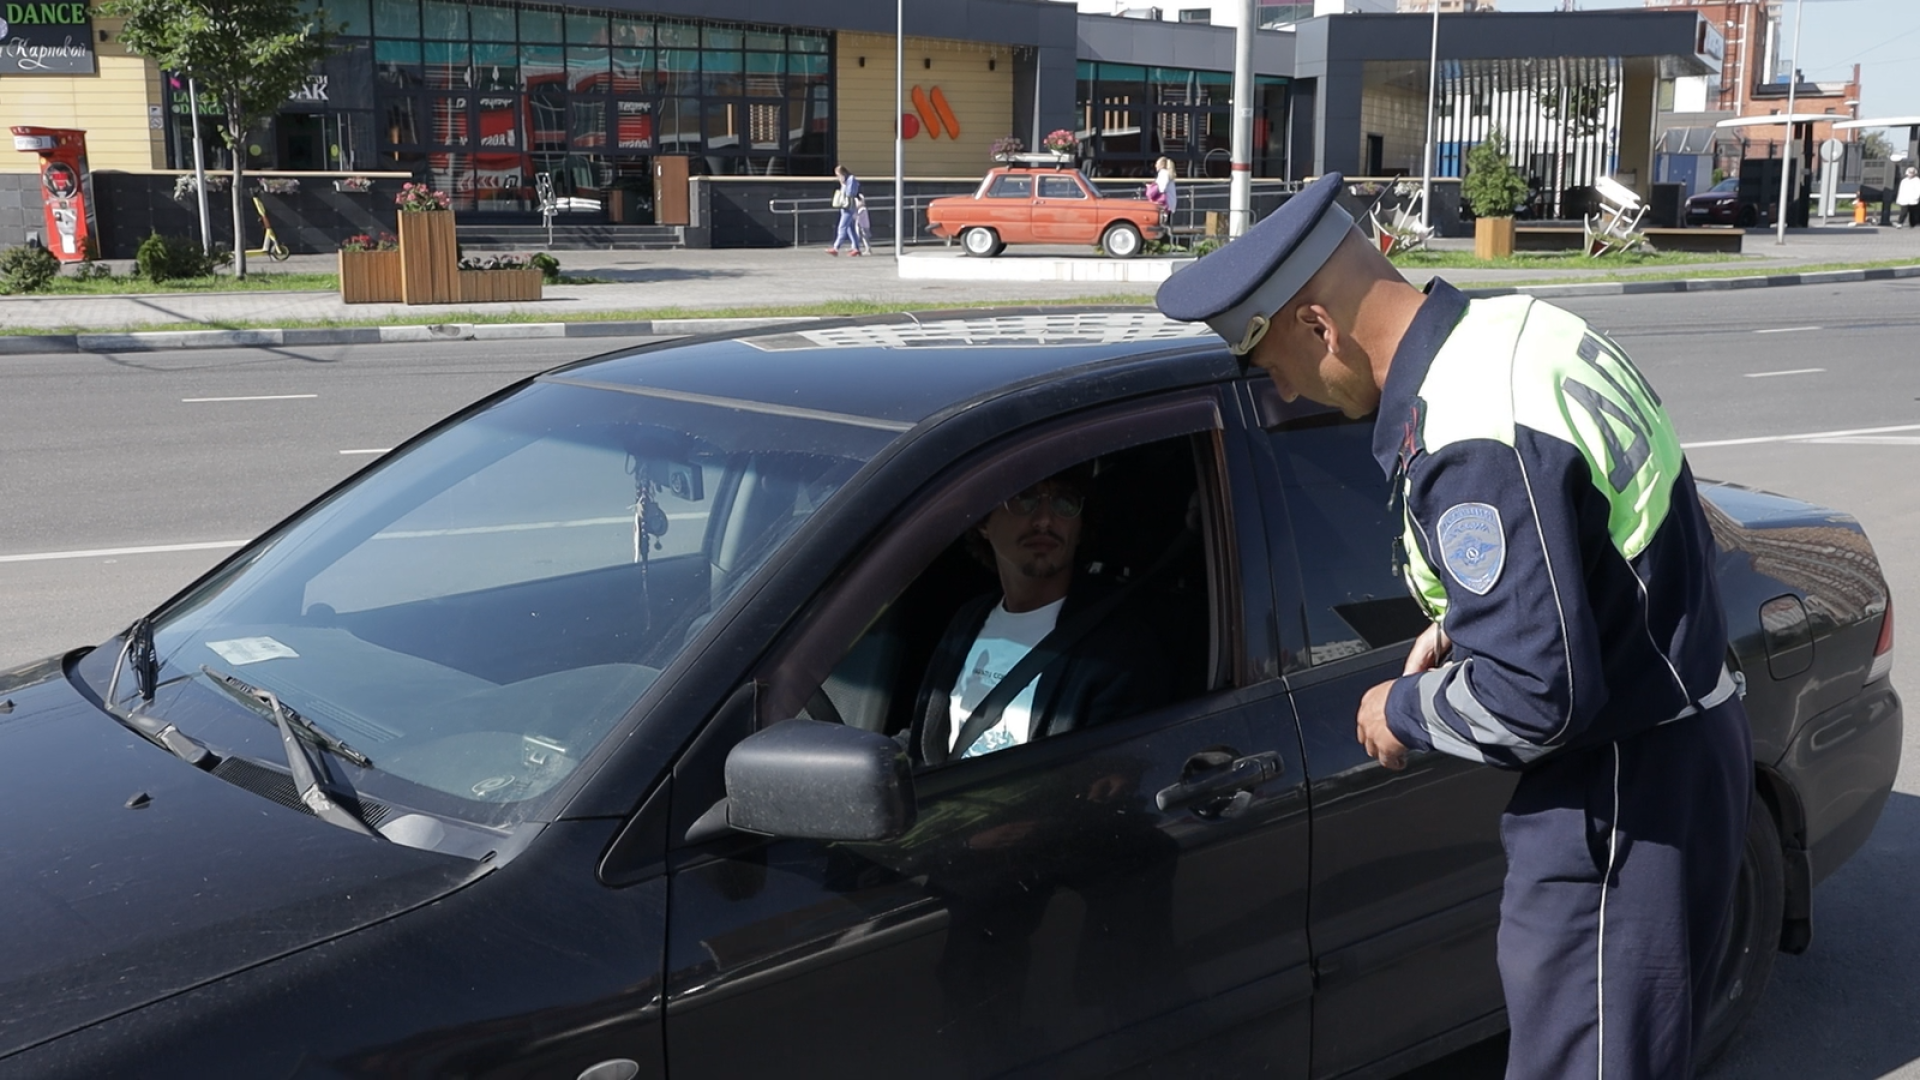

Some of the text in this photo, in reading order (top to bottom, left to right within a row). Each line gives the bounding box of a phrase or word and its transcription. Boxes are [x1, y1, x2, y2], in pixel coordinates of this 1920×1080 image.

[6, 3, 86, 24] DANCE
[6, 35, 87, 70] Карповой
[180, 104, 225, 115] DNCE
